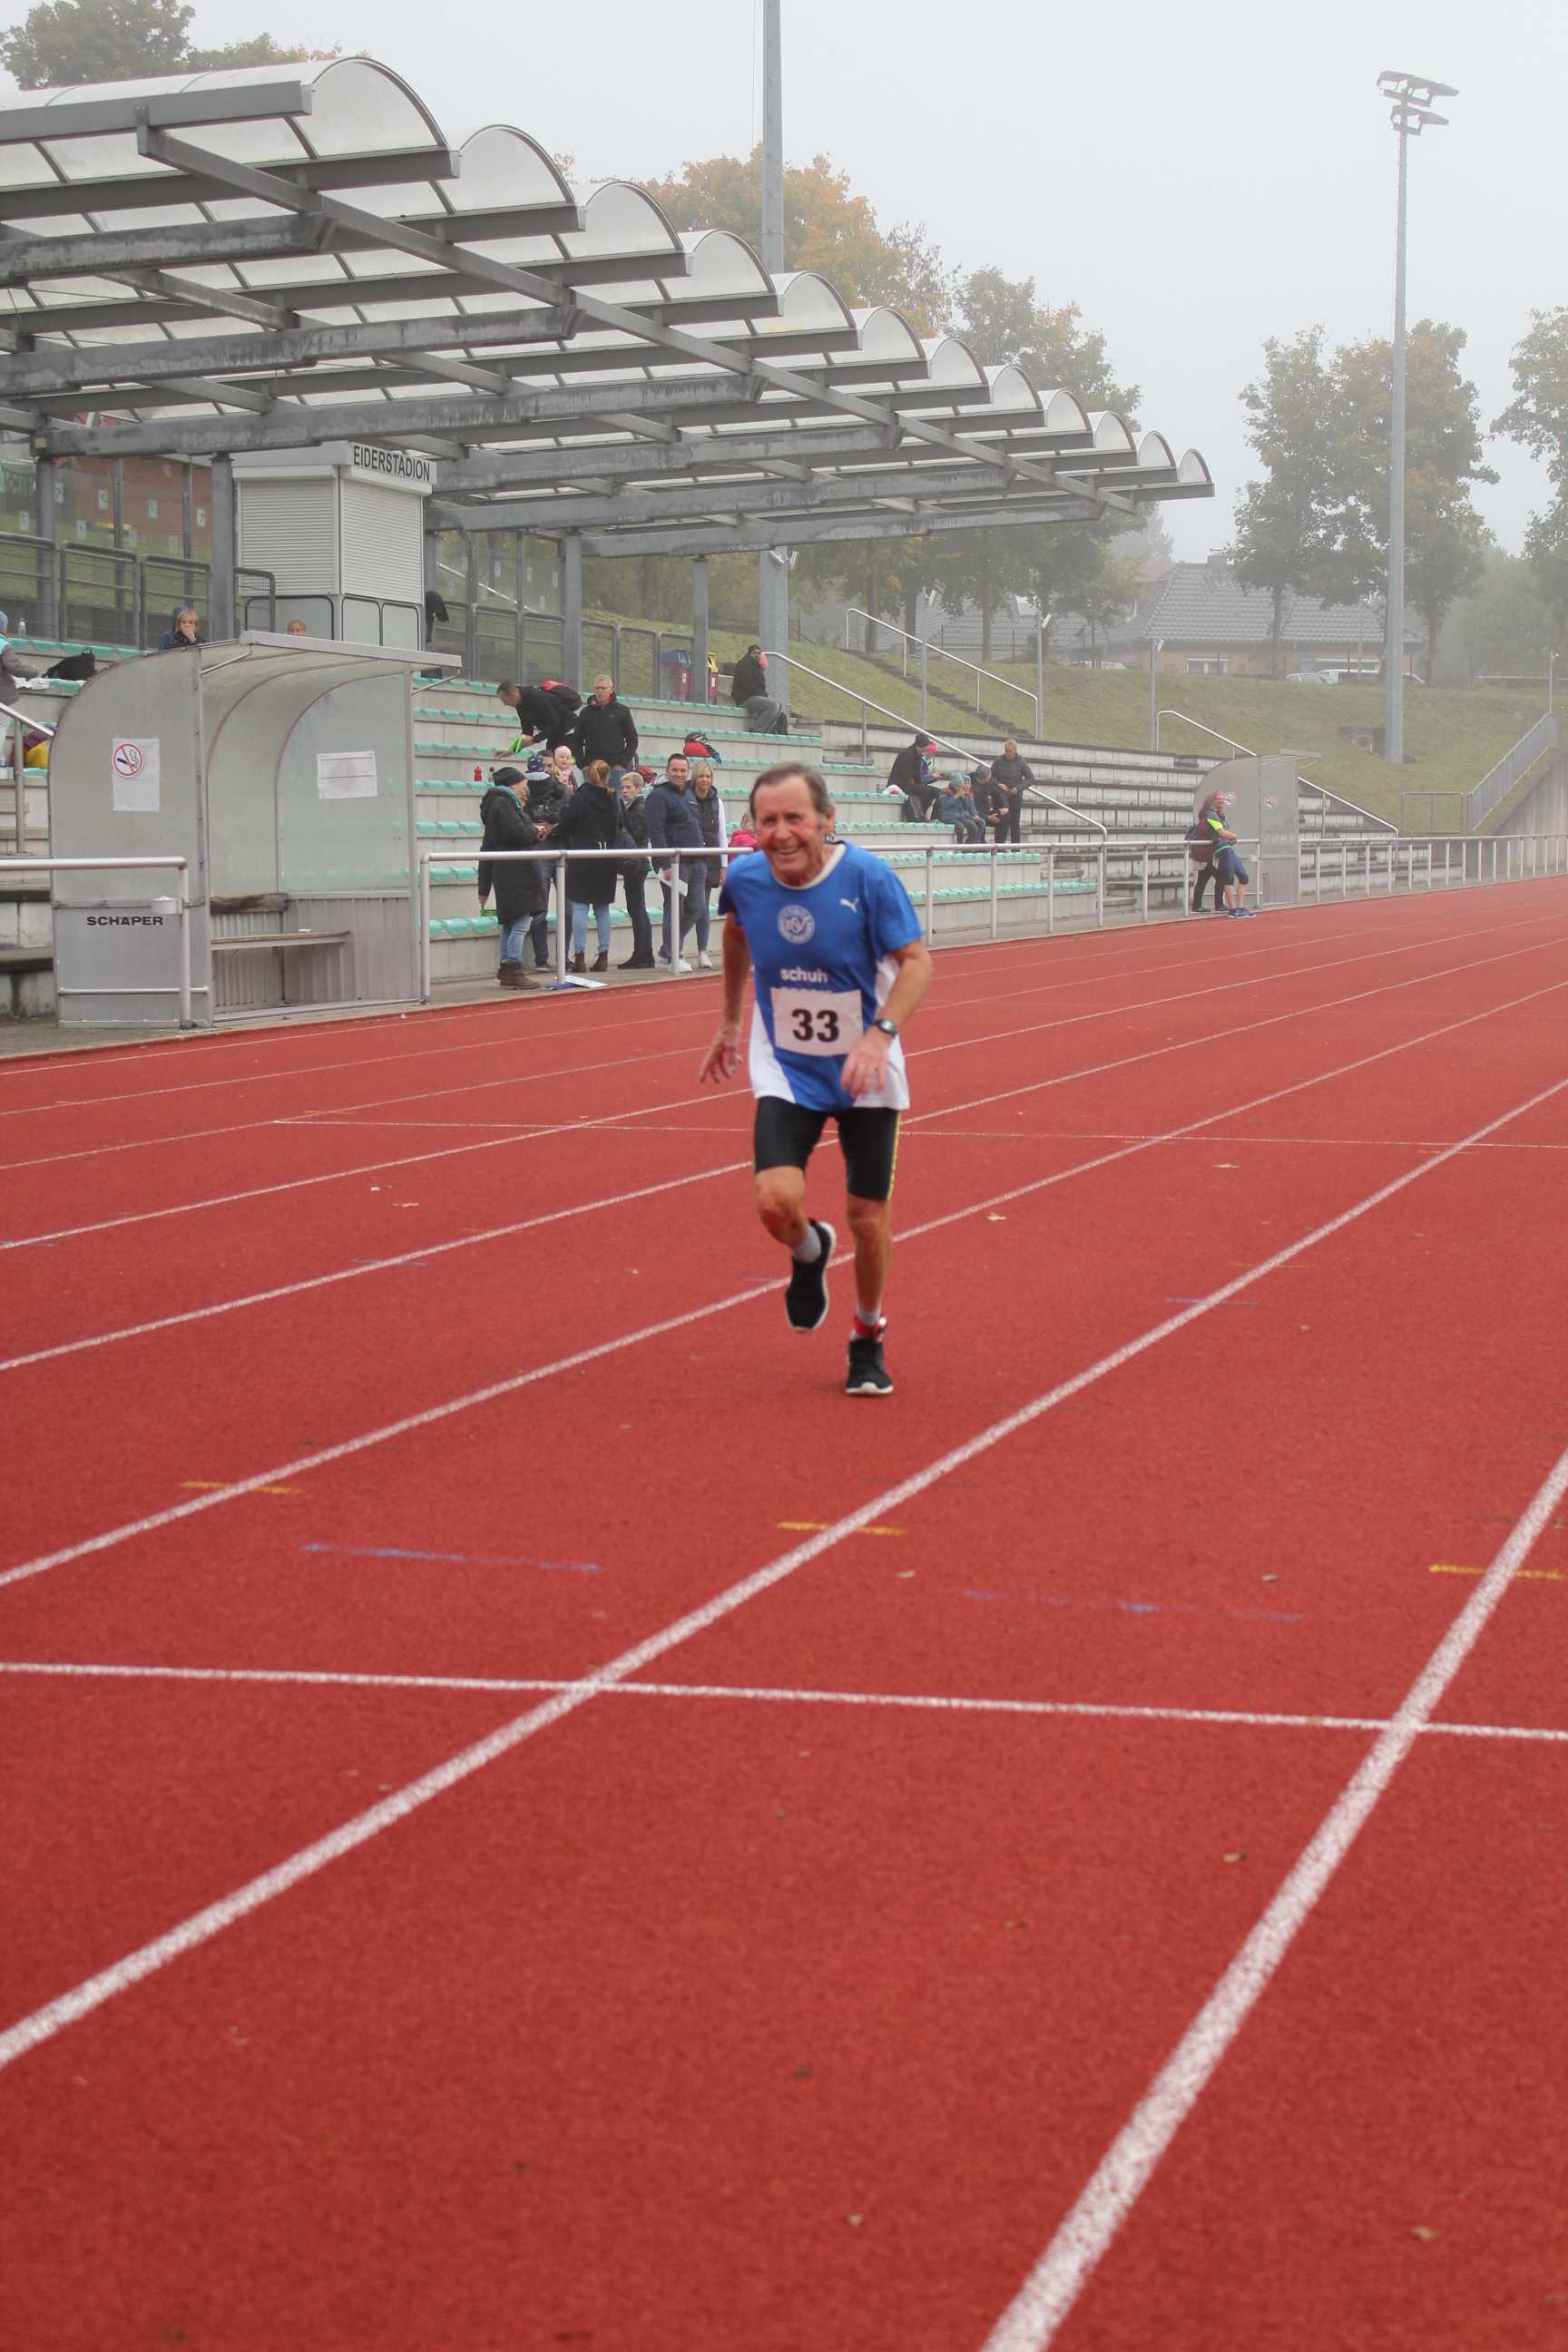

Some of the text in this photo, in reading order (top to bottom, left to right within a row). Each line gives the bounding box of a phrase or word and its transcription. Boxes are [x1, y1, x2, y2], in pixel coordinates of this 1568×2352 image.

[354, 446, 430, 481] EIDERSTADION
[780, 965, 828, 983] schuh
[791, 1009, 839, 1043] 33
